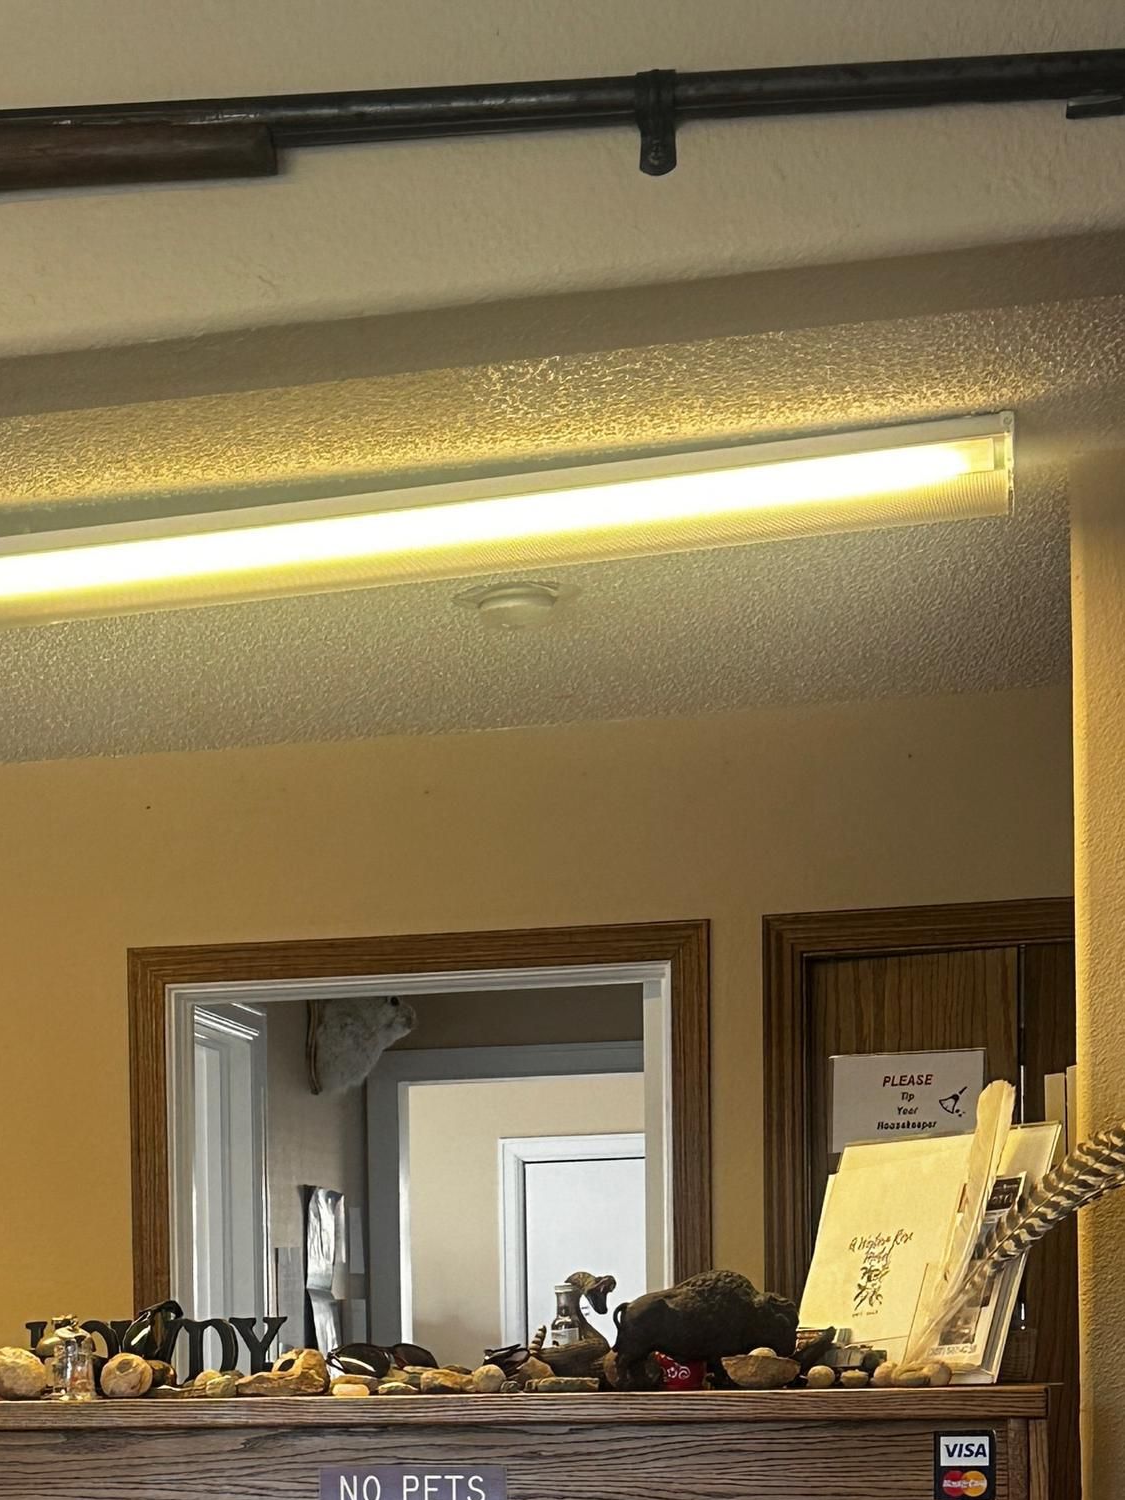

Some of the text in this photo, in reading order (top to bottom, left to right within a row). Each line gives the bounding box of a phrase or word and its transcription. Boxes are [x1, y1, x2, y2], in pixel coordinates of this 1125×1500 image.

[883, 1074, 933, 1087] PLEASE
[901, 1092, 915, 1102] Tip
[897, 1106, 918, 1115] Your
[945, 1443, 987, 1457] VISA
